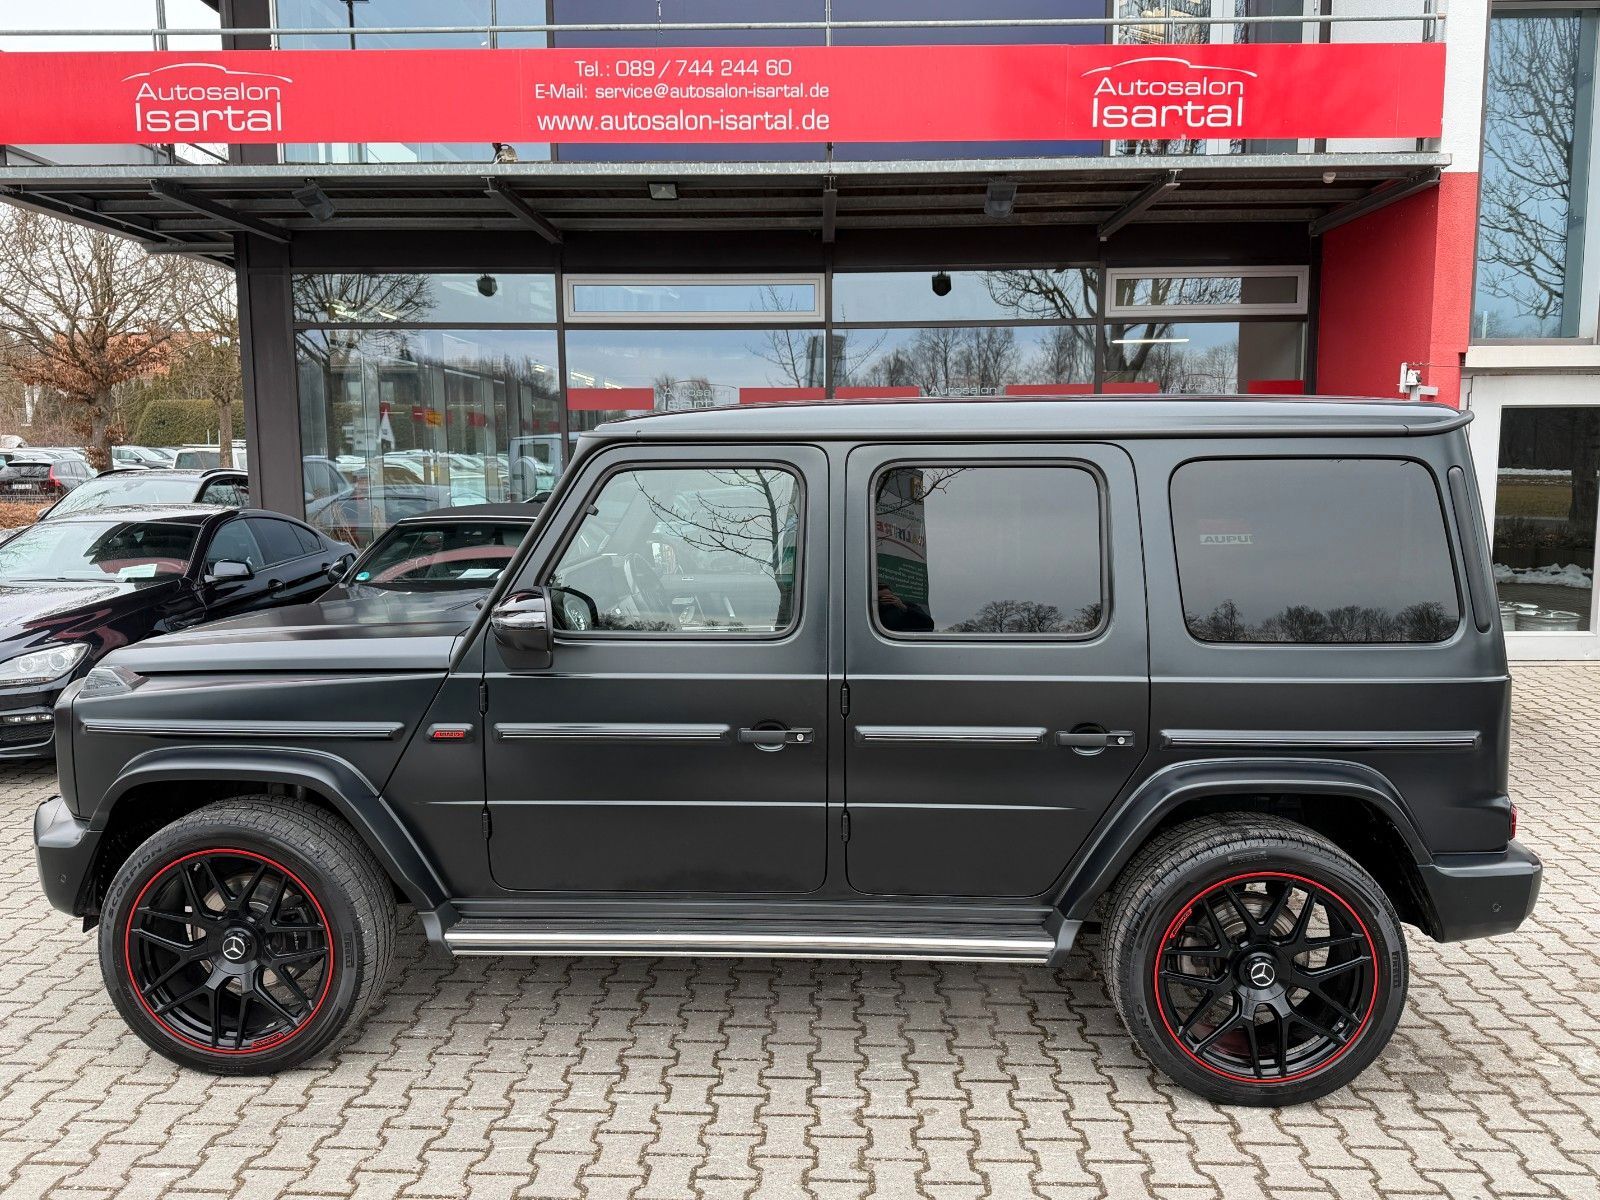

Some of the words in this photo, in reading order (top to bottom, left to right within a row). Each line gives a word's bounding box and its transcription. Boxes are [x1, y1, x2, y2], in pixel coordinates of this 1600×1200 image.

[574, 60, 609, 77] Tel.:
[615, 60, 654, 77] 089
[657, 60, 670, 78] /
[675, 60, 714, 76] 744
[720, 60, 759, 76] 244
[765, 59, 792, 76] 60
[135, 82, 281, 101] Autosalon
[535, 84, 587, 99] E-Mail:
[595, 83, 829, 99] service@autosalon-isartal.de
[1094, 77, 1244, 96] Autosalon
[135, 101, 282, 132] Isartal
[537, 109, 830, 131] www.autosalon-isartal.de
[1092, 97, 1244, 128] Isartal
